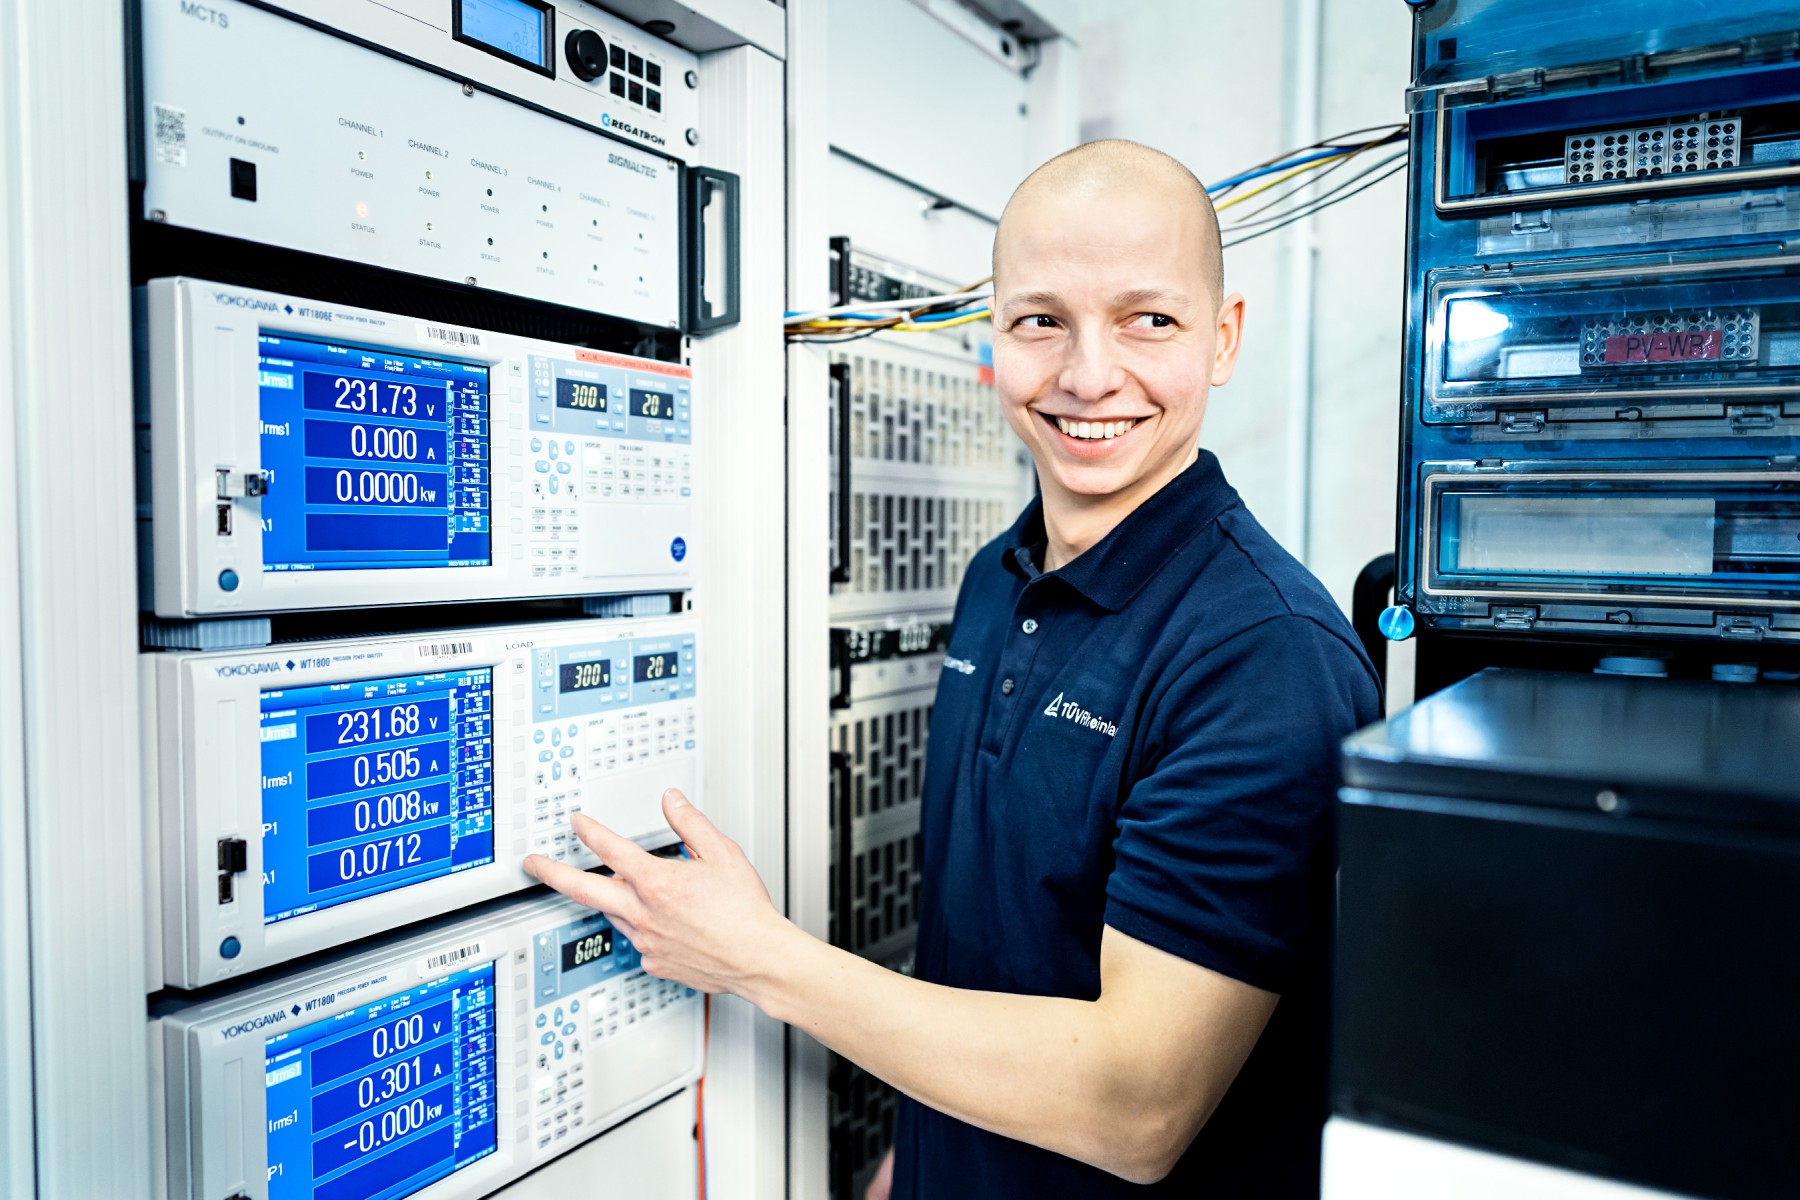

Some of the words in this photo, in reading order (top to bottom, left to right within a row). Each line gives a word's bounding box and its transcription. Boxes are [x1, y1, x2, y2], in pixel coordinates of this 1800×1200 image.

[180, 0, 229, 28] MCTS
[338, 117, 377, 137] CHANNEL
[379, 130, 384, 138] 1
[611, 118, 666, 146] REGATRON
[408, 139, 442, 157] CHANNEL
[444, 150, 449, 158] 2
[351, 168, 374, 180] POWER
[470, 158, 502, 175] CHANNEL
[503, 168, 508, 177] 3
[608, 153, 657, 178] SIGNALTEC
[418, 187, 440, 198] POWER
[527, 176, 556, 191] CHANNEL
[480, 203, 500, 214] POWER
[351, 222, 375, 235] STATUS
[419, 239, 441, 250] STATUS
[480, 253, 501, 264] STATUS
[214, 292, 279, 313] YOKOGAWA
[298, 307, 333, 322] WT1806E
[1626, 334, 1706, 360] PV-WR
[334, 377, 417, 417] 231.73
[426, 404, 435, 417] V
[571, 383, 598, 409] 300
[642, 393, 660, 416] 20
[260, 420, 290, 436] Irms1
[351, 425, 417, 460] 0.000
[427, 448, 435, 460] A
[336, 469, 417, 504] 0.0000
[506, 641, 534, 651] LOAD
[215, 662, 280, 678] YOKOGAWA
[300, 657, 330, 669] WT1800
[574, 663, 602, 688] 300
[646, 656, 664, 679] 20
[260, 722, 296, 741] Urms1
[337, 704, 420, 744] 231.68
[429, 717, 438, 730] V
[1062, 702, 1117, 737] TÜVRheinla
[354, 748, 420, 788] 0.505
[430, 760, 438, 772] A
[263, 772, 293, 790] Irms1
[355, 791, 420, 832] 0.008
[262, 822, 278, 838] P1
[339, 834, 421, 881] 0.0712
[574, 934, 604, 965] 600
[221, 1010, 287, 1040] YOKOGAWA
[305, 994, 335, 1012] WT1800
[337, 985, 356, 997] PRECISION
[357, 981, 370, 991] POWER
[370, 975, 388, 988] ANALYZER
[373, 1014, 423, 1058] 0.00
[433, 1021, 441, 1035] V
[266, 1061, 301, 1088] Urms1
[358, 1056, 421, 1108] 0.301
[434, 1064, 442, 1077] A
[269, 1110, 298, 1133] Irms1
[344, 1098, 424, 1152] -0.000
[267, 1162, 283, 1181] P1
